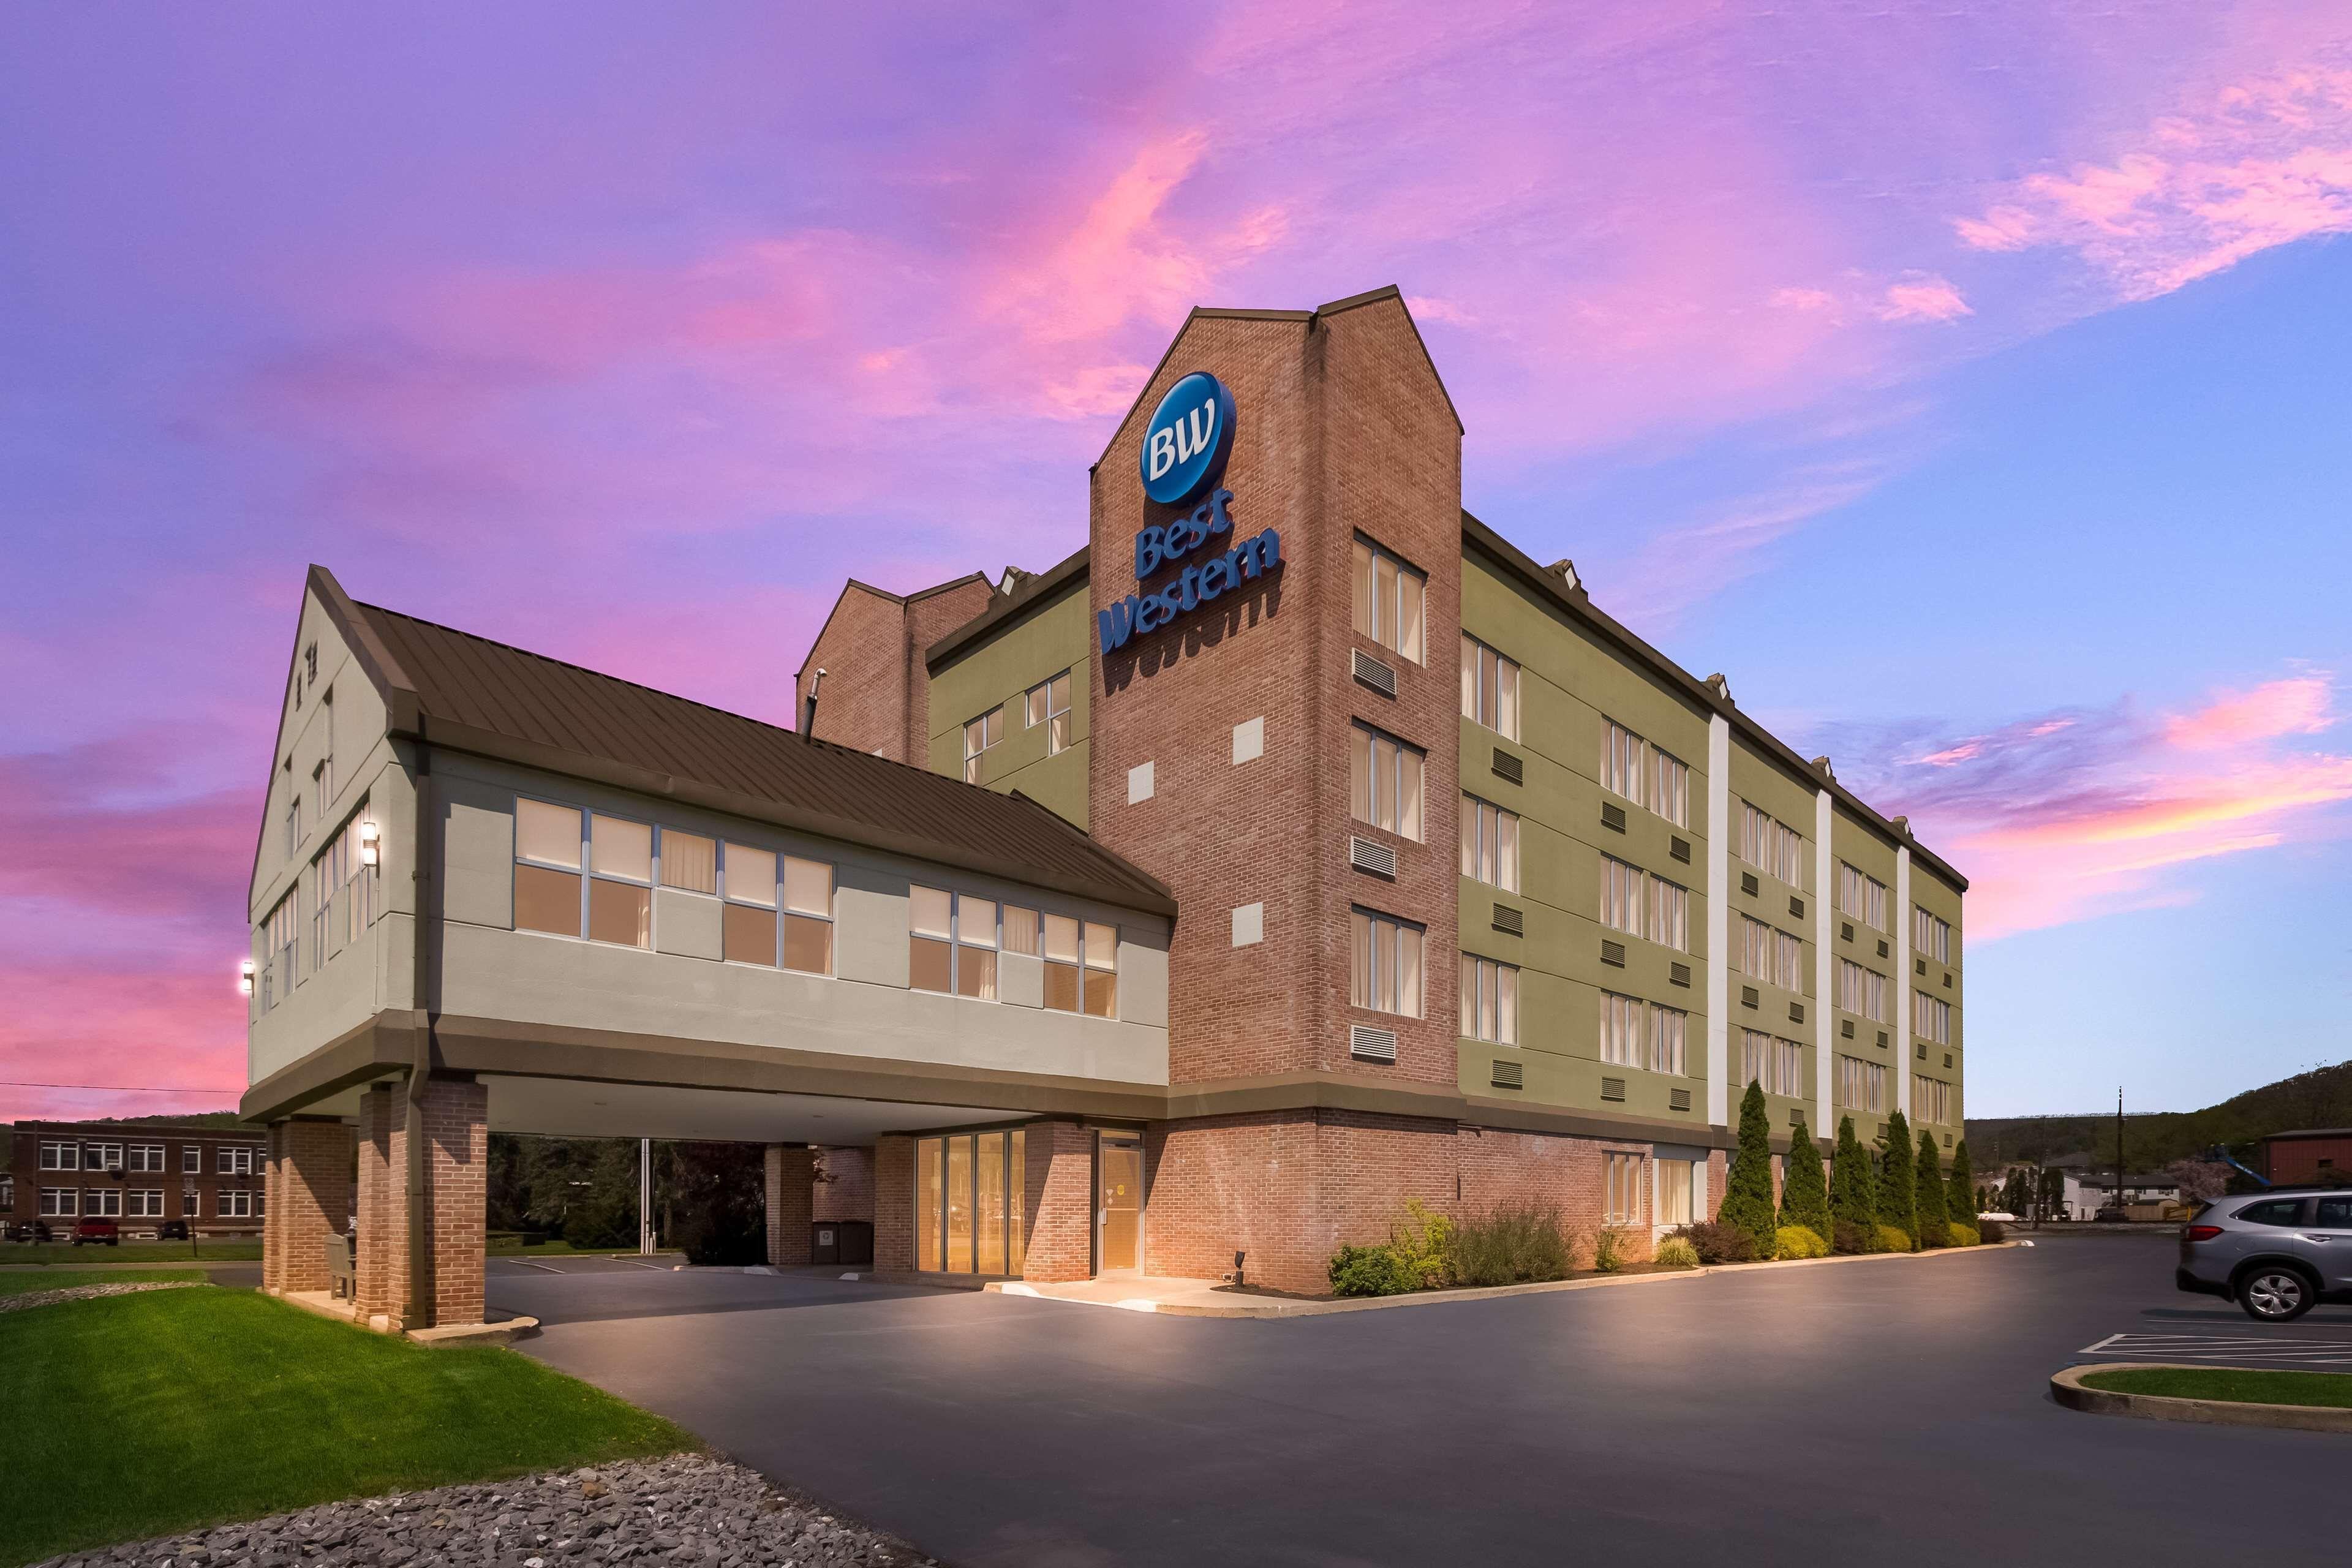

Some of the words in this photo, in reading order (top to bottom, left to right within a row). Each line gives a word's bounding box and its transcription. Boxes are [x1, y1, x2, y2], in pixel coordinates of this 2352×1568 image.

[1150, 398, 1215, 482] BW
[1135, 488, 1234, 581] Best
[1098, 527, 1280, 655] Western
